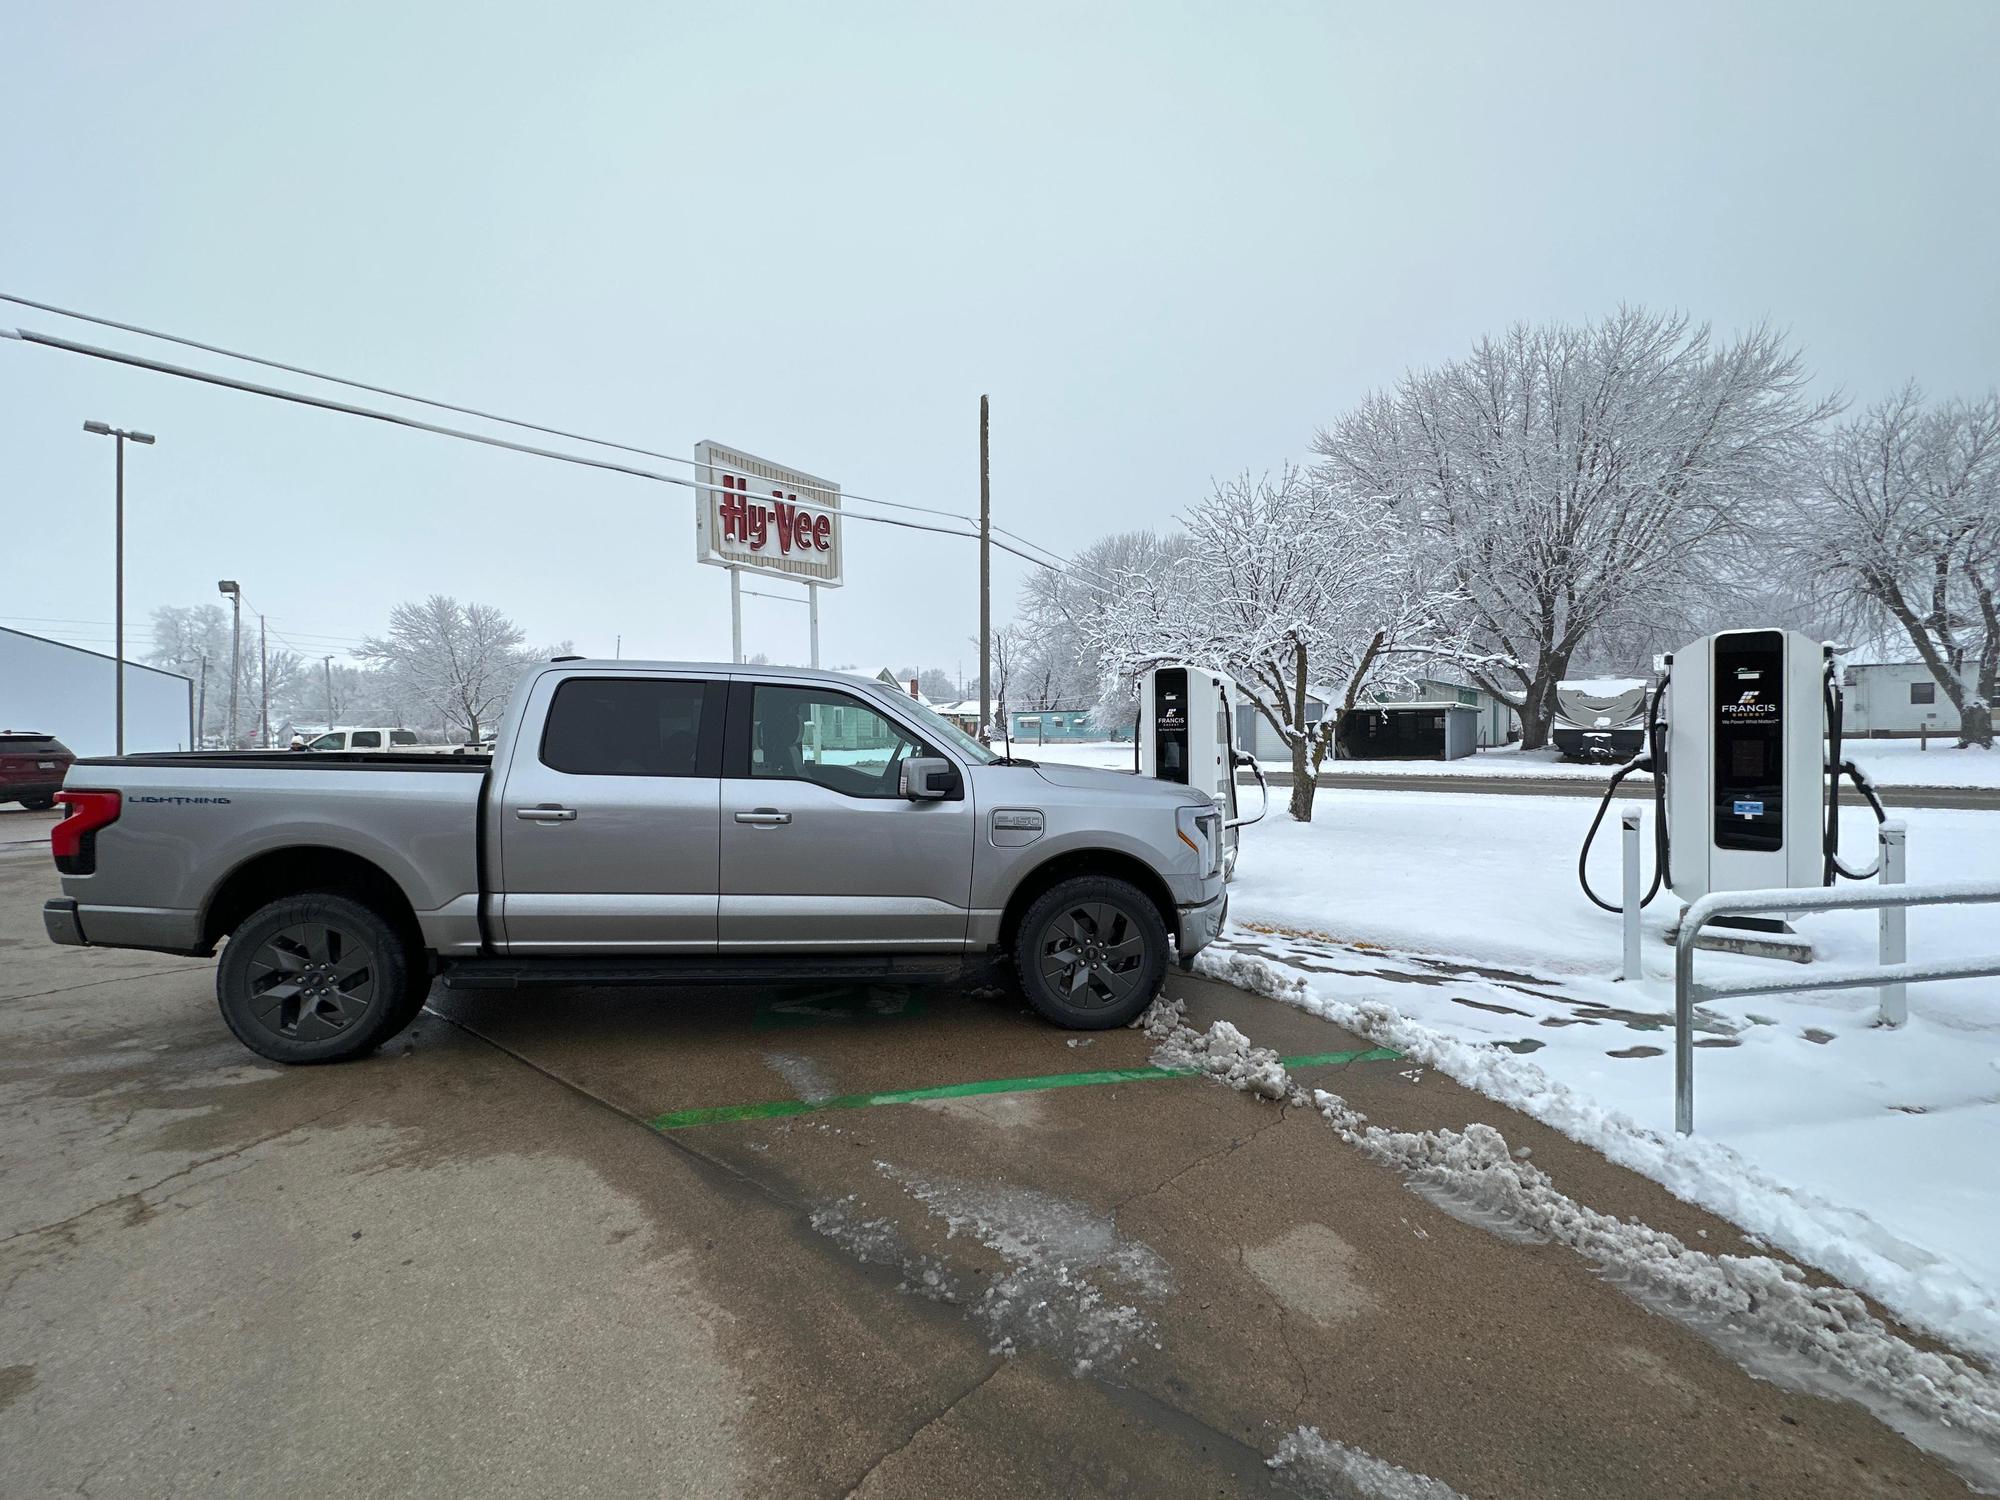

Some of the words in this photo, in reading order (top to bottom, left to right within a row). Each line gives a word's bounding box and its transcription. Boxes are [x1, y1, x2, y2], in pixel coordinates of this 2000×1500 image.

[720, 475, 831, 555] Hy-Vee
[1721, 704, 1776, 712] FRANCIS
[128, 796, 231, 805] LIGHTNING
[995, 816, 1042, 826] F-150
